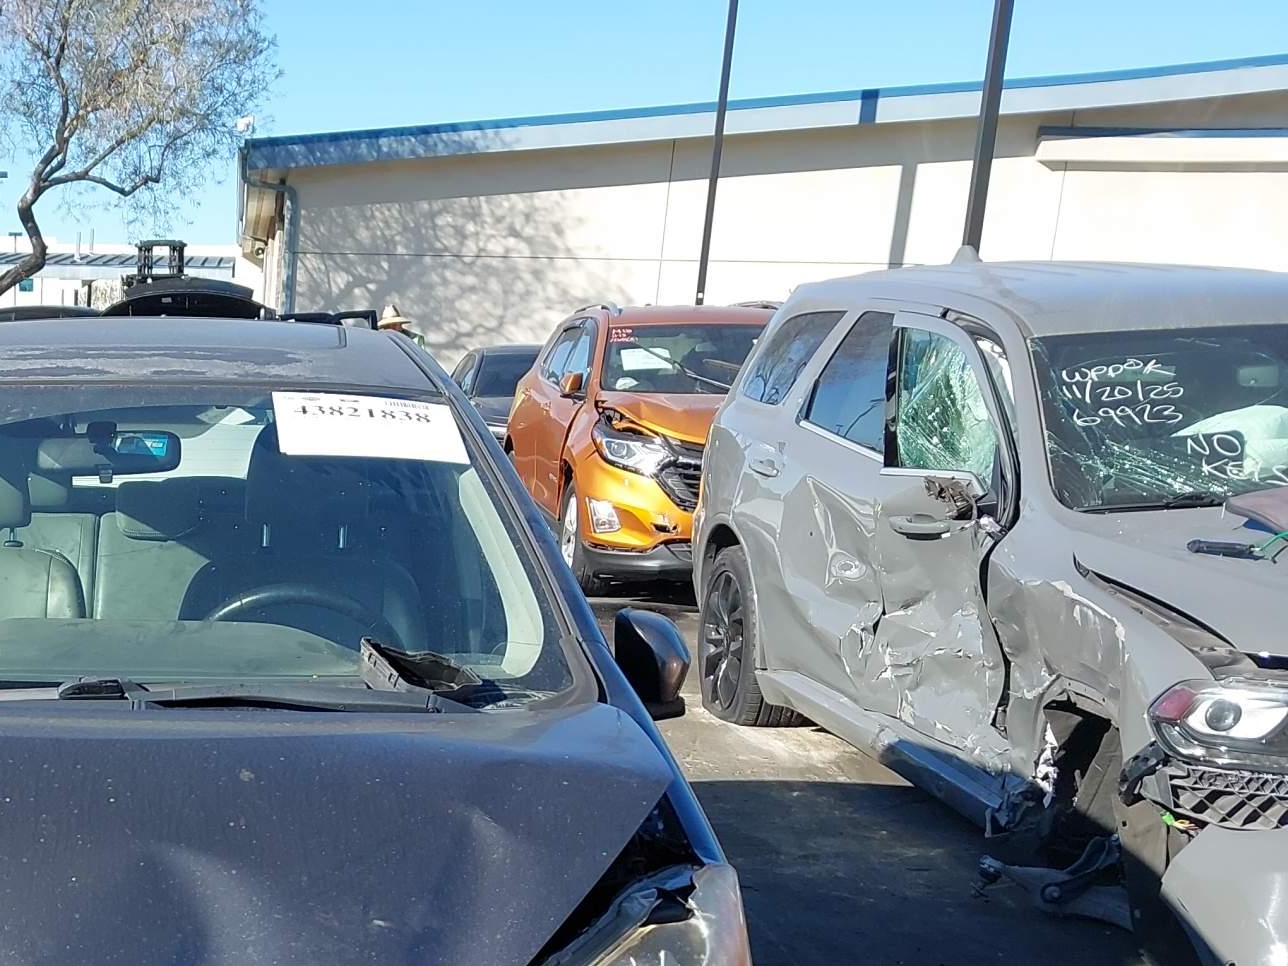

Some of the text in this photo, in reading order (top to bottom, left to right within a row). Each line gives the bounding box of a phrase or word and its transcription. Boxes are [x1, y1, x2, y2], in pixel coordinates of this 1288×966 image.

[1062, 379, 1184, 404] 11/20/25
[294, 405, 431, 423] 43821838
[1073, 404, 1184, 428] 69923
[1186, 433, 1242, 456] NO
